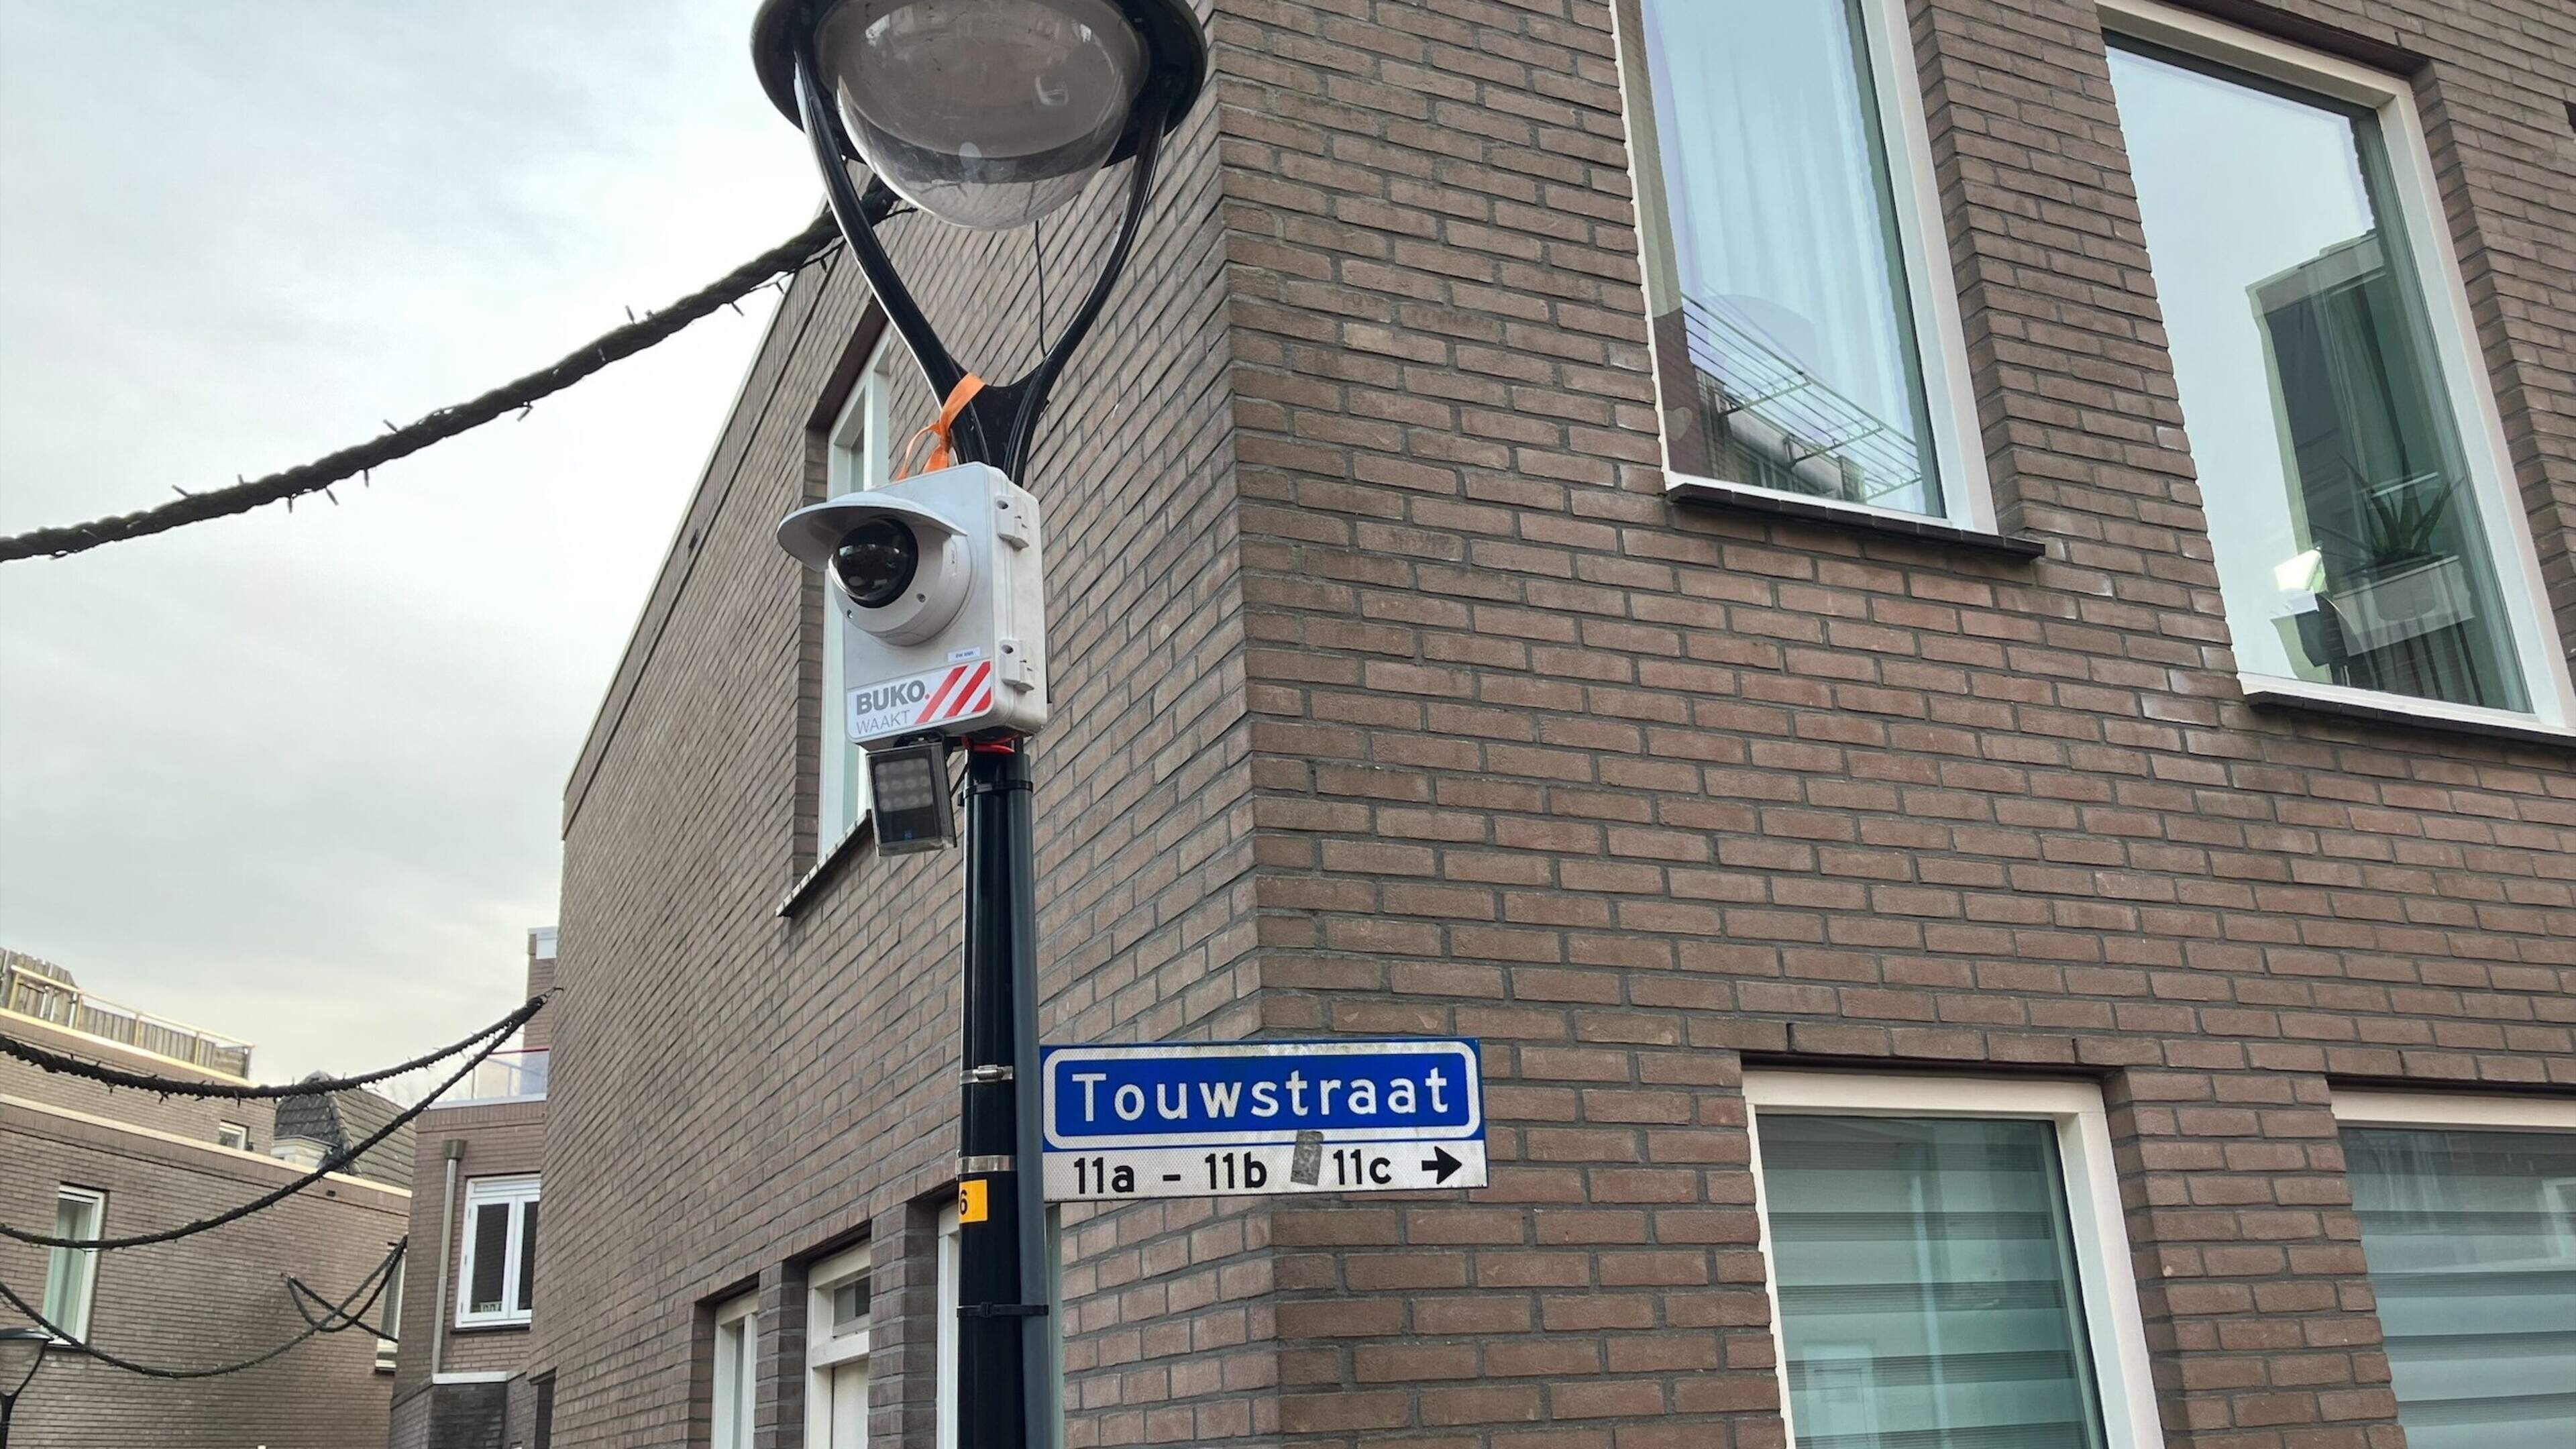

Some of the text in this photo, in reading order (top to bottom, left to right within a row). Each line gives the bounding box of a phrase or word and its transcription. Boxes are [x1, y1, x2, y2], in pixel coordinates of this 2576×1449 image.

[856, 709, 911, 735] WAAKT
[1071, 1067, 1448, 1122] Touwstraat
[1074, 1157, 1134, 1194] 11a
[1204, 1151, 1268, 1190] 11b
[1332, 1148, 1392, 1186] 11c
[959, 1189, 968, 1216] 6
